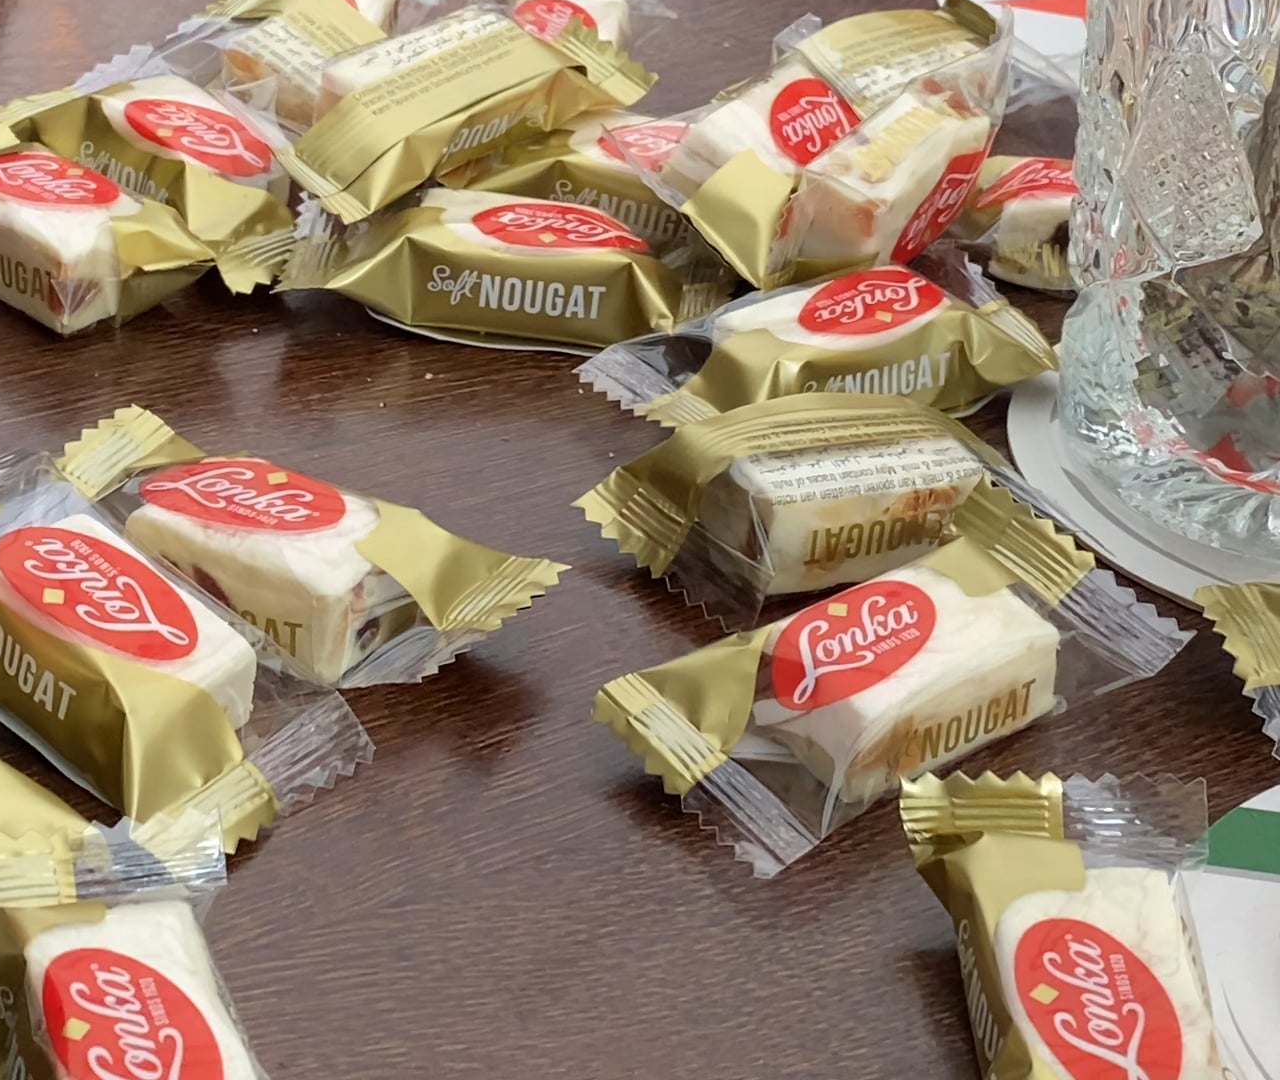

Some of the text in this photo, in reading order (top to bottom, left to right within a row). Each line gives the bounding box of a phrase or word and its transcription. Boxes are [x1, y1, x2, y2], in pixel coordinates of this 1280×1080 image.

[146, 103, 265, 168] Lonka
[491, 211, 643, 242] Lonka
[427, 265, 606, 319] Soft NOUGAT
[814, 277, 926, 323] Lonka
[145, 467, 314, 522] Lonka
[803, 517, 926, 565] NOUGAT
[23, 538, 190, 646] Lonka
[793, 595, 918, 704] Lonka
[920, 678, 1036, 763] NOUGAT
[1042, 938, 1152, 1080] Lonka
